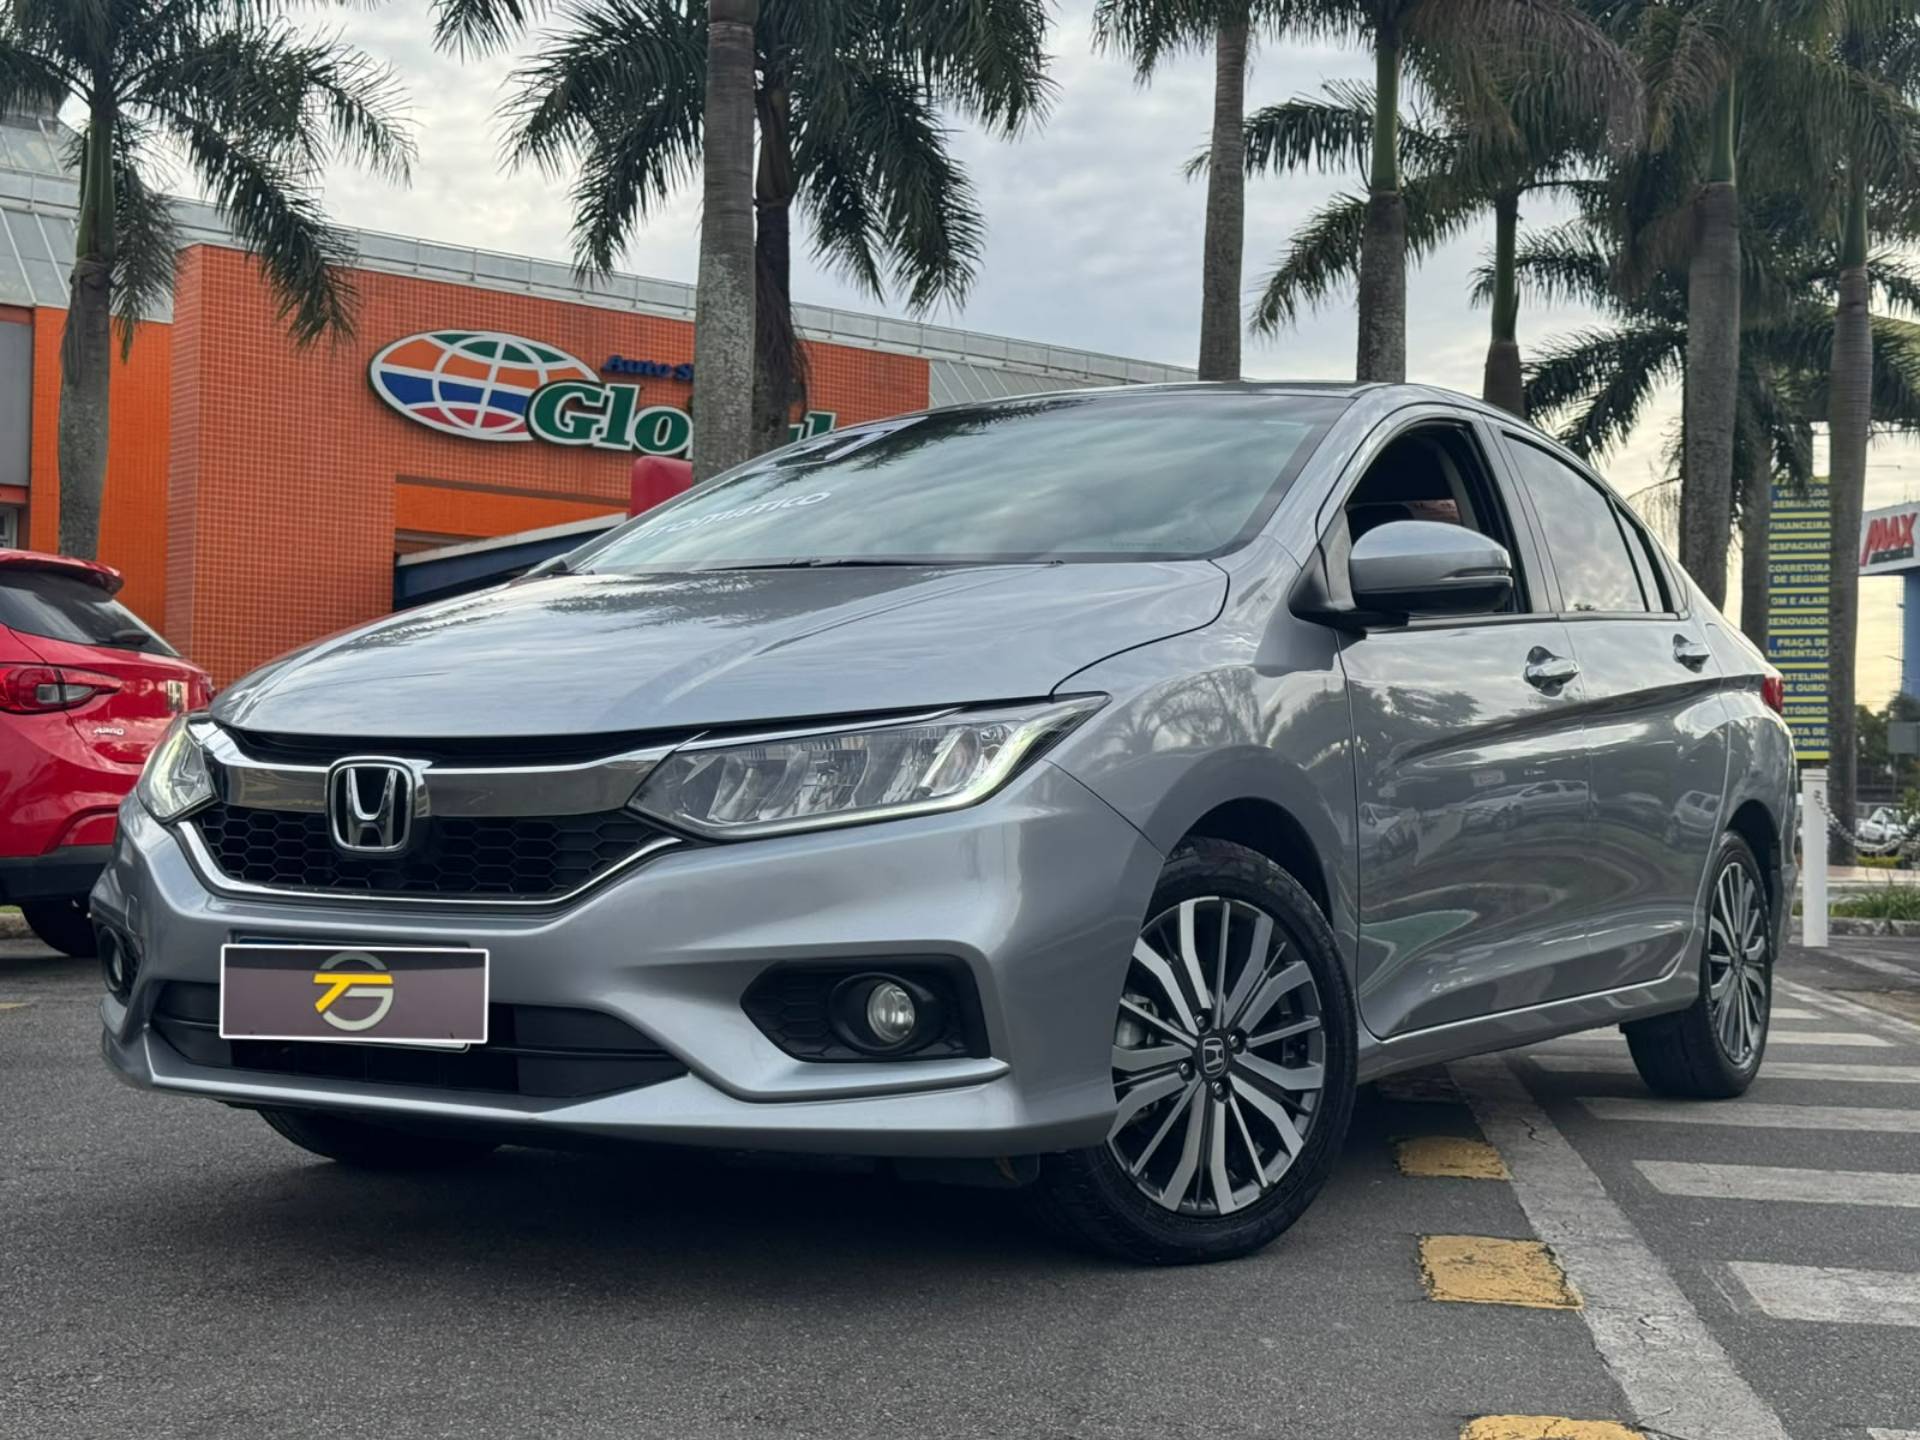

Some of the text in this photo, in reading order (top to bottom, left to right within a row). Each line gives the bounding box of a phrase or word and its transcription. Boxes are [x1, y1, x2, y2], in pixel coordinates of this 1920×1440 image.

[603, 354, 672, 378] Auto
[528, 379, 836, 459] Glol
[1768, 563, 1830, 573] CORRETORA
[1773, 575, 1787, 584] DE
[1776, 637, 1828, 648] PRAÇA DE
[1796, 683, 1826, 693] OURO
